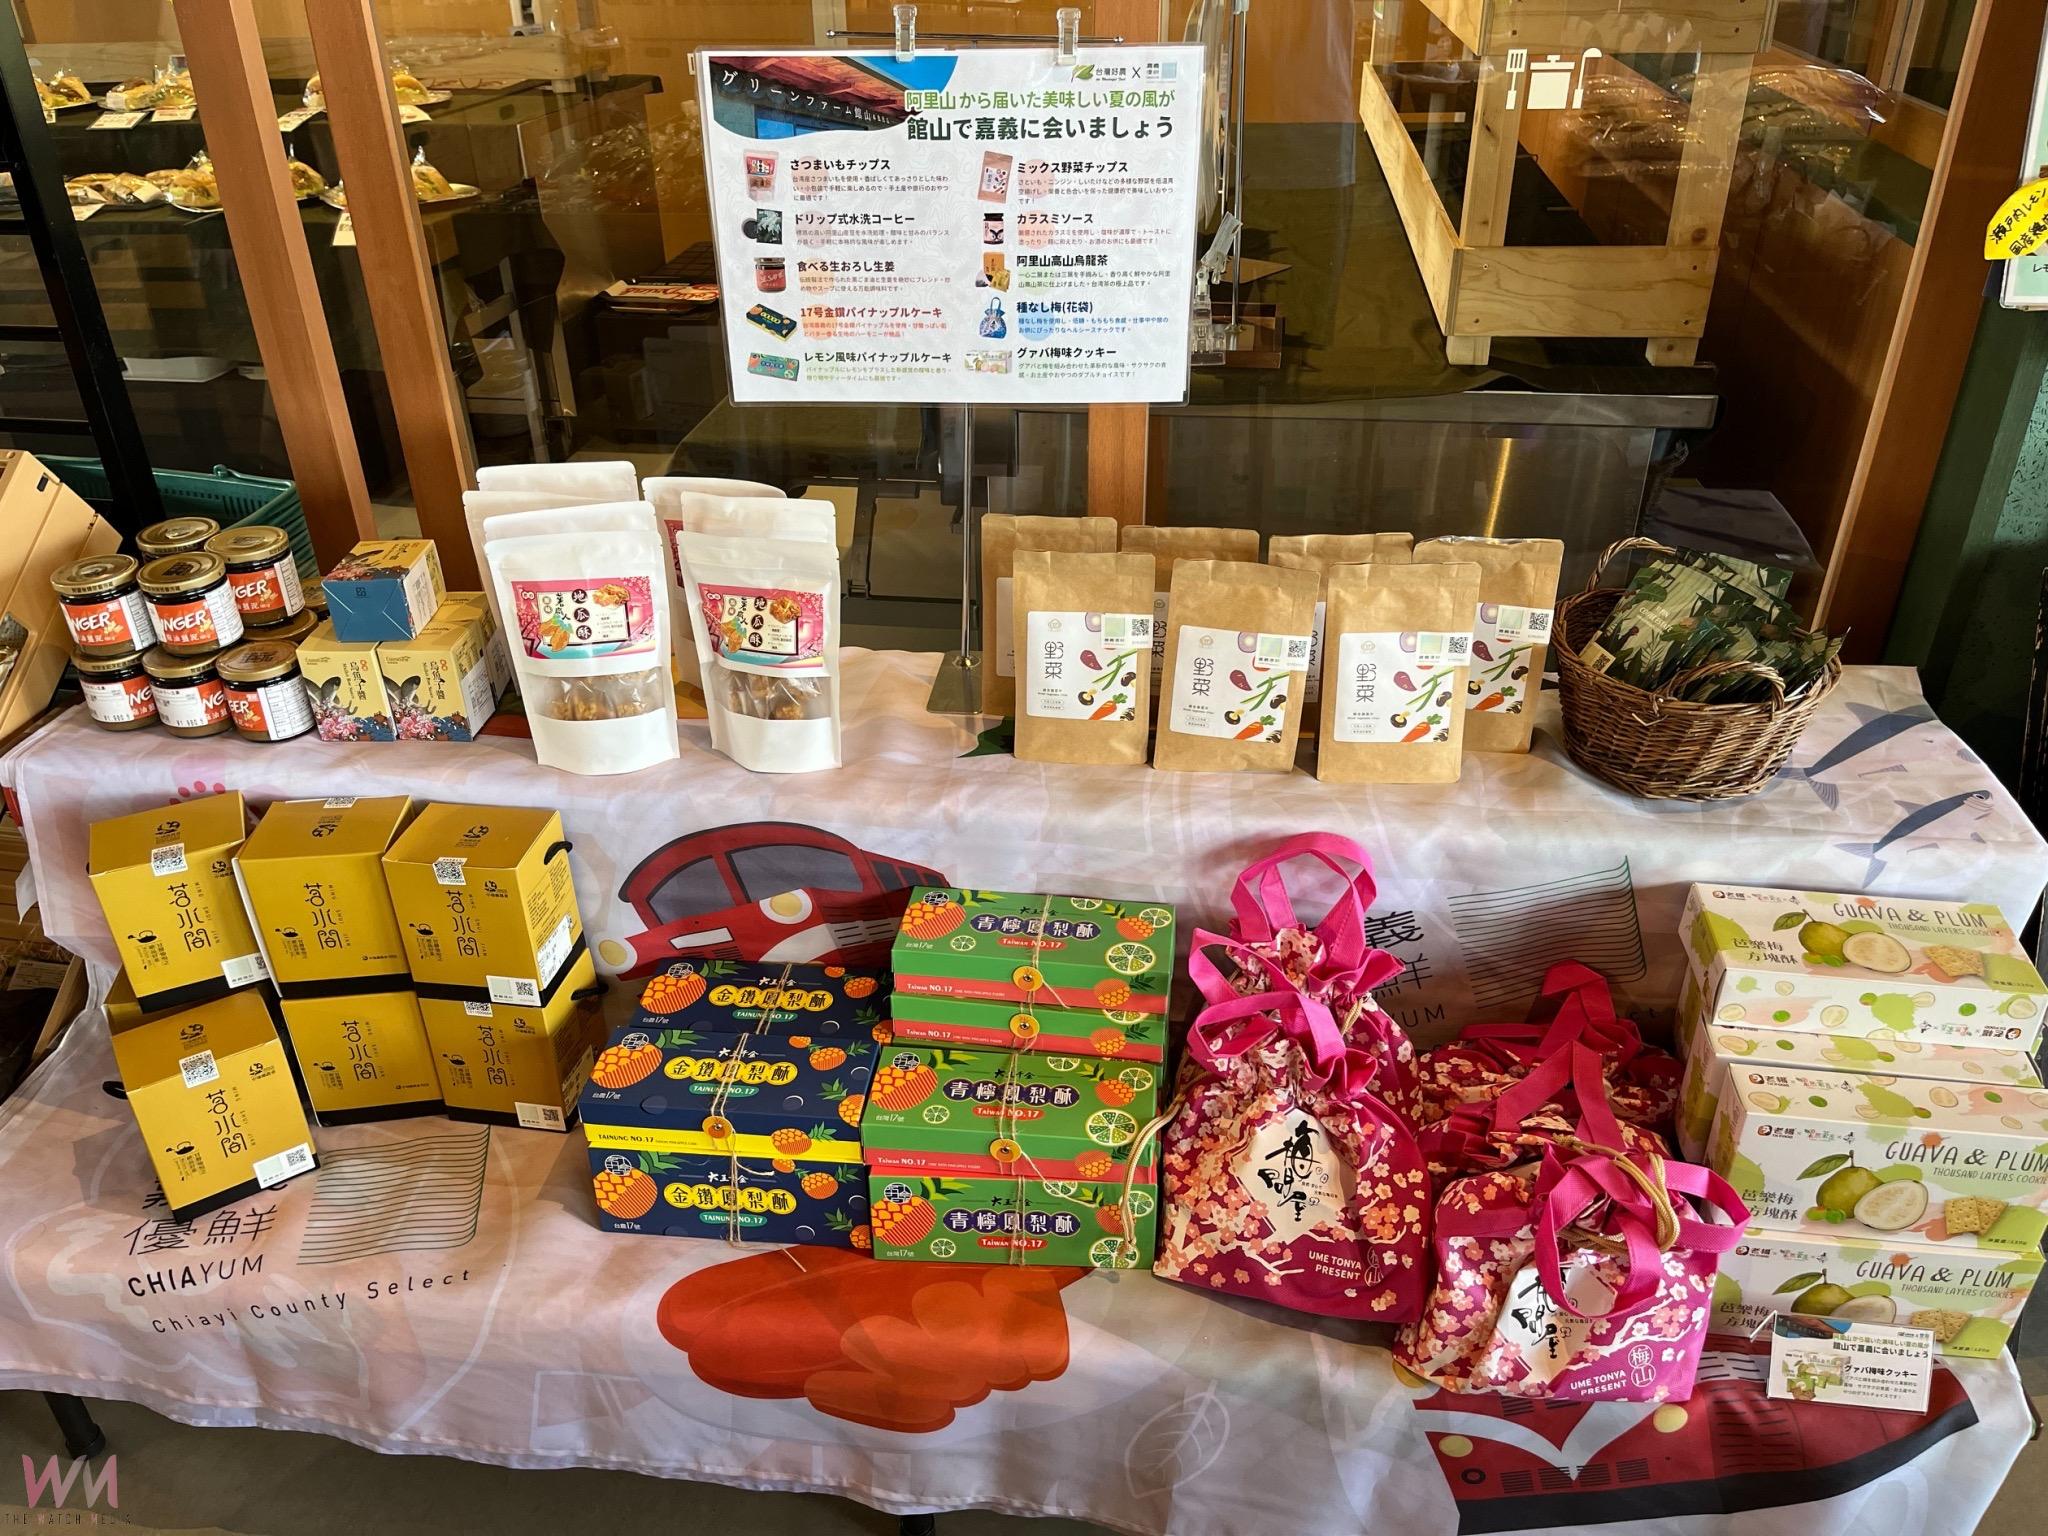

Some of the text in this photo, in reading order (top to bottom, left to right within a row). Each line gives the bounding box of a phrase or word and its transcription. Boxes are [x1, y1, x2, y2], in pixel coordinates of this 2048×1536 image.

[907, 90, 1175, 110] 阿里山から届いた美味しい夏の風が
[908, 116, 1173, 140] 館山で嘉義に会いましょう
[790, 158, 891, 171] さつまいもチップス
[1017, 161, 1128, 173] ミックス野菜チップス
[795, 213, 915, 225] ドリップ式水洗コーヒー
[1017, 213, 1094, 224] カラスミソース
[797, 261, 895, 273] 食べる生おろし生姜
[1017, 255, 1109, 267] 阿里山高山烏龍茶
[800, 307, 943, 319] 17号金鑽パイナップルケーキ
[1017, 301, 1094, 314] 種なし梅(花袋)
[804, 352, 952, 364] レモン風味パイナップルケーキ
[1017, 347, 1117, 360] グァバ梅味クッキー
[572, 589, 592, 640] 地瓜酥
[749, 596, 767, 647] 地瓜酥
[1044, 641, 1064, 679] 野菜
[1192, 657, 1214, 697] 野菜
[1356, 663, 1377, 703] 野菜
[1833, 902, 1989, 929] GUAVA & PLUM
[929, 984, 953, 993] NO.17
[928, 1029, 951, 1039] NO.17
[598, 1133, 629, 1142] TAINUNG
[630, 1134, 654, 1144] NO.17
[901, 1157, 926, 1166] NO.17
[1886, 1141, 1959, 1166] GUAVA
[1964, 1149, 1989, 1166] &
[1933, 1167, 2048, 1185] THOUSAND LAYERS COOKIE
[1742, 1189, 1794, 1206] 芭樂梅
[1749, 1205, 1799, 1222] 方塊酥
[124, 1205, 278, 1256] 優鮮
[1012, 1238, 1044, 1248] NO.17
[1308, 1250, 1362, 1271] UME TONYA
[127, 1254, 264, 1298] CHIAYUM
[1315, 1264, 1361, 1281] PRESENT
[1857, 1260, 2015, 1289] GUAVA & PLUM
[1901, 1283, 2016, 1300] THOUSAND LAYERS COOKIES
[152, 1269, 470, 1334] Chiayi County Select
[1720, 1301, 1770, 1317] 芭樂梅
[1629, 1346, 1655, 1386] 梅山
[1844, 1365, 1919, 1378] グァバ梅味クッキー
[1570, 1369, 1626, 1391] UME TONYA
[1580, 1380, 1627, 1397] PRESENT
